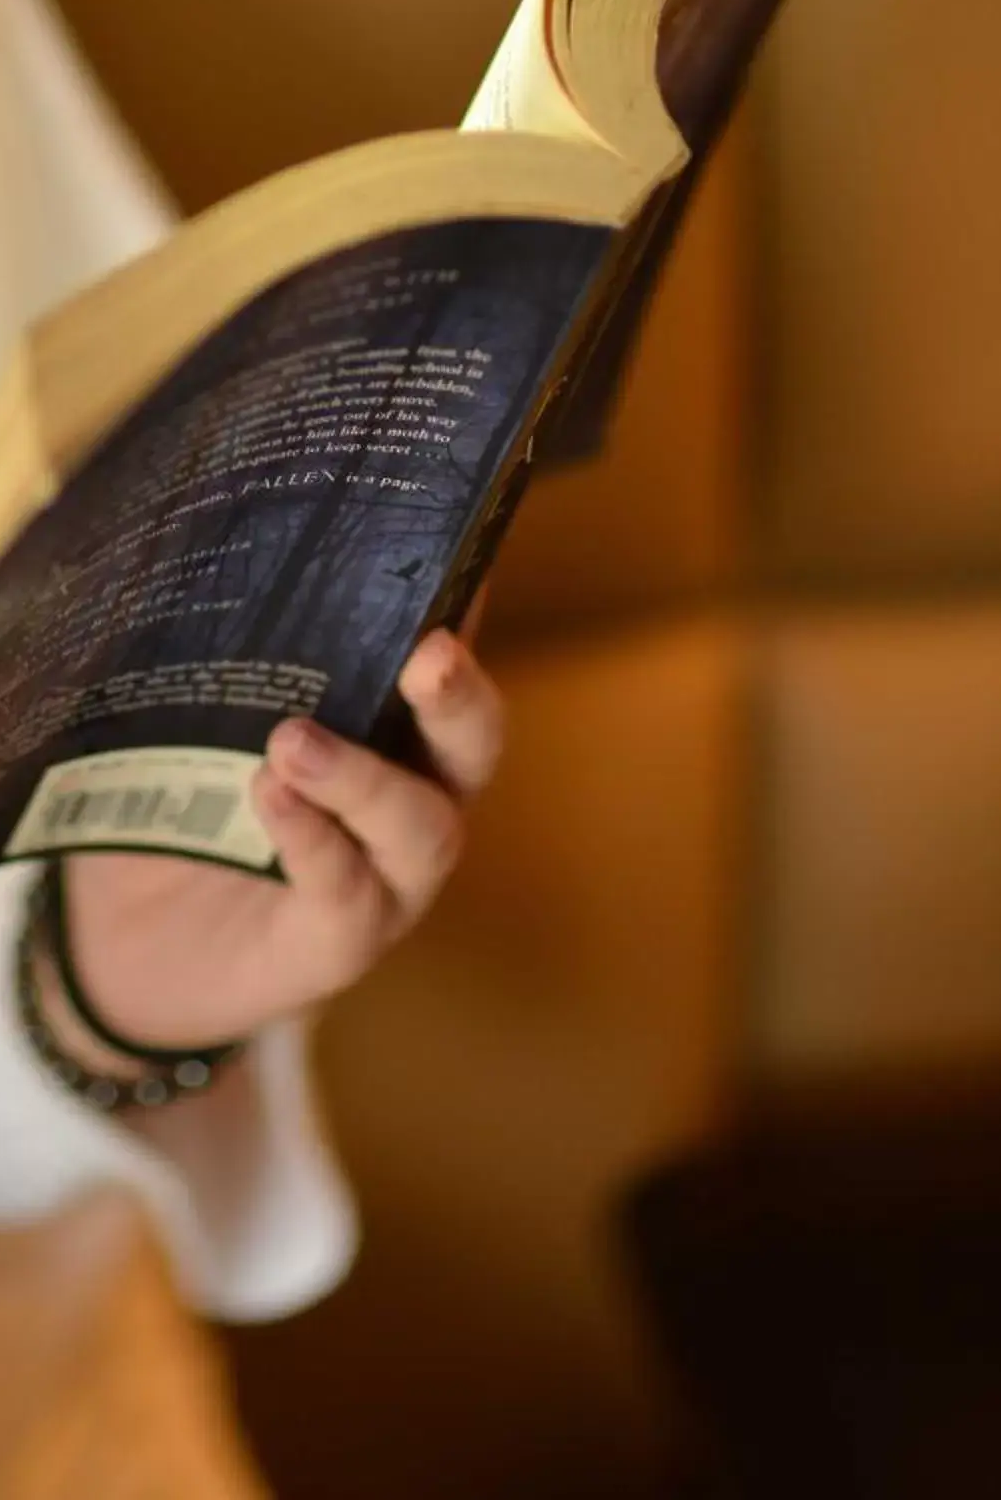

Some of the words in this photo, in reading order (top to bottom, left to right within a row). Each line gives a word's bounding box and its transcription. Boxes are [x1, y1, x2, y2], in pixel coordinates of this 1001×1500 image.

[464, 347, 492, 363] the
[465, 365, 484, 379] in
[343, 410, 372, 422] out
[374, 409, 397, 421] of
[396, 409, 421, 422] his
[426, 415, 459, 430] way
[306, 427, 337, 441] him
[339, 424, 369, 438] like
[372, 427, 383, 437] a
[386, 428, 430, 441] moth
[433, 432, 451, 444] to
[324, 441, 363, 457] keep
[366, 443, 412, 456] secret
[240, 467, 337, 497] FALLEN
[345, 472, 360, 484] is
[364, 475, 376, 485] a
[379, 476, 428, 492] page-
